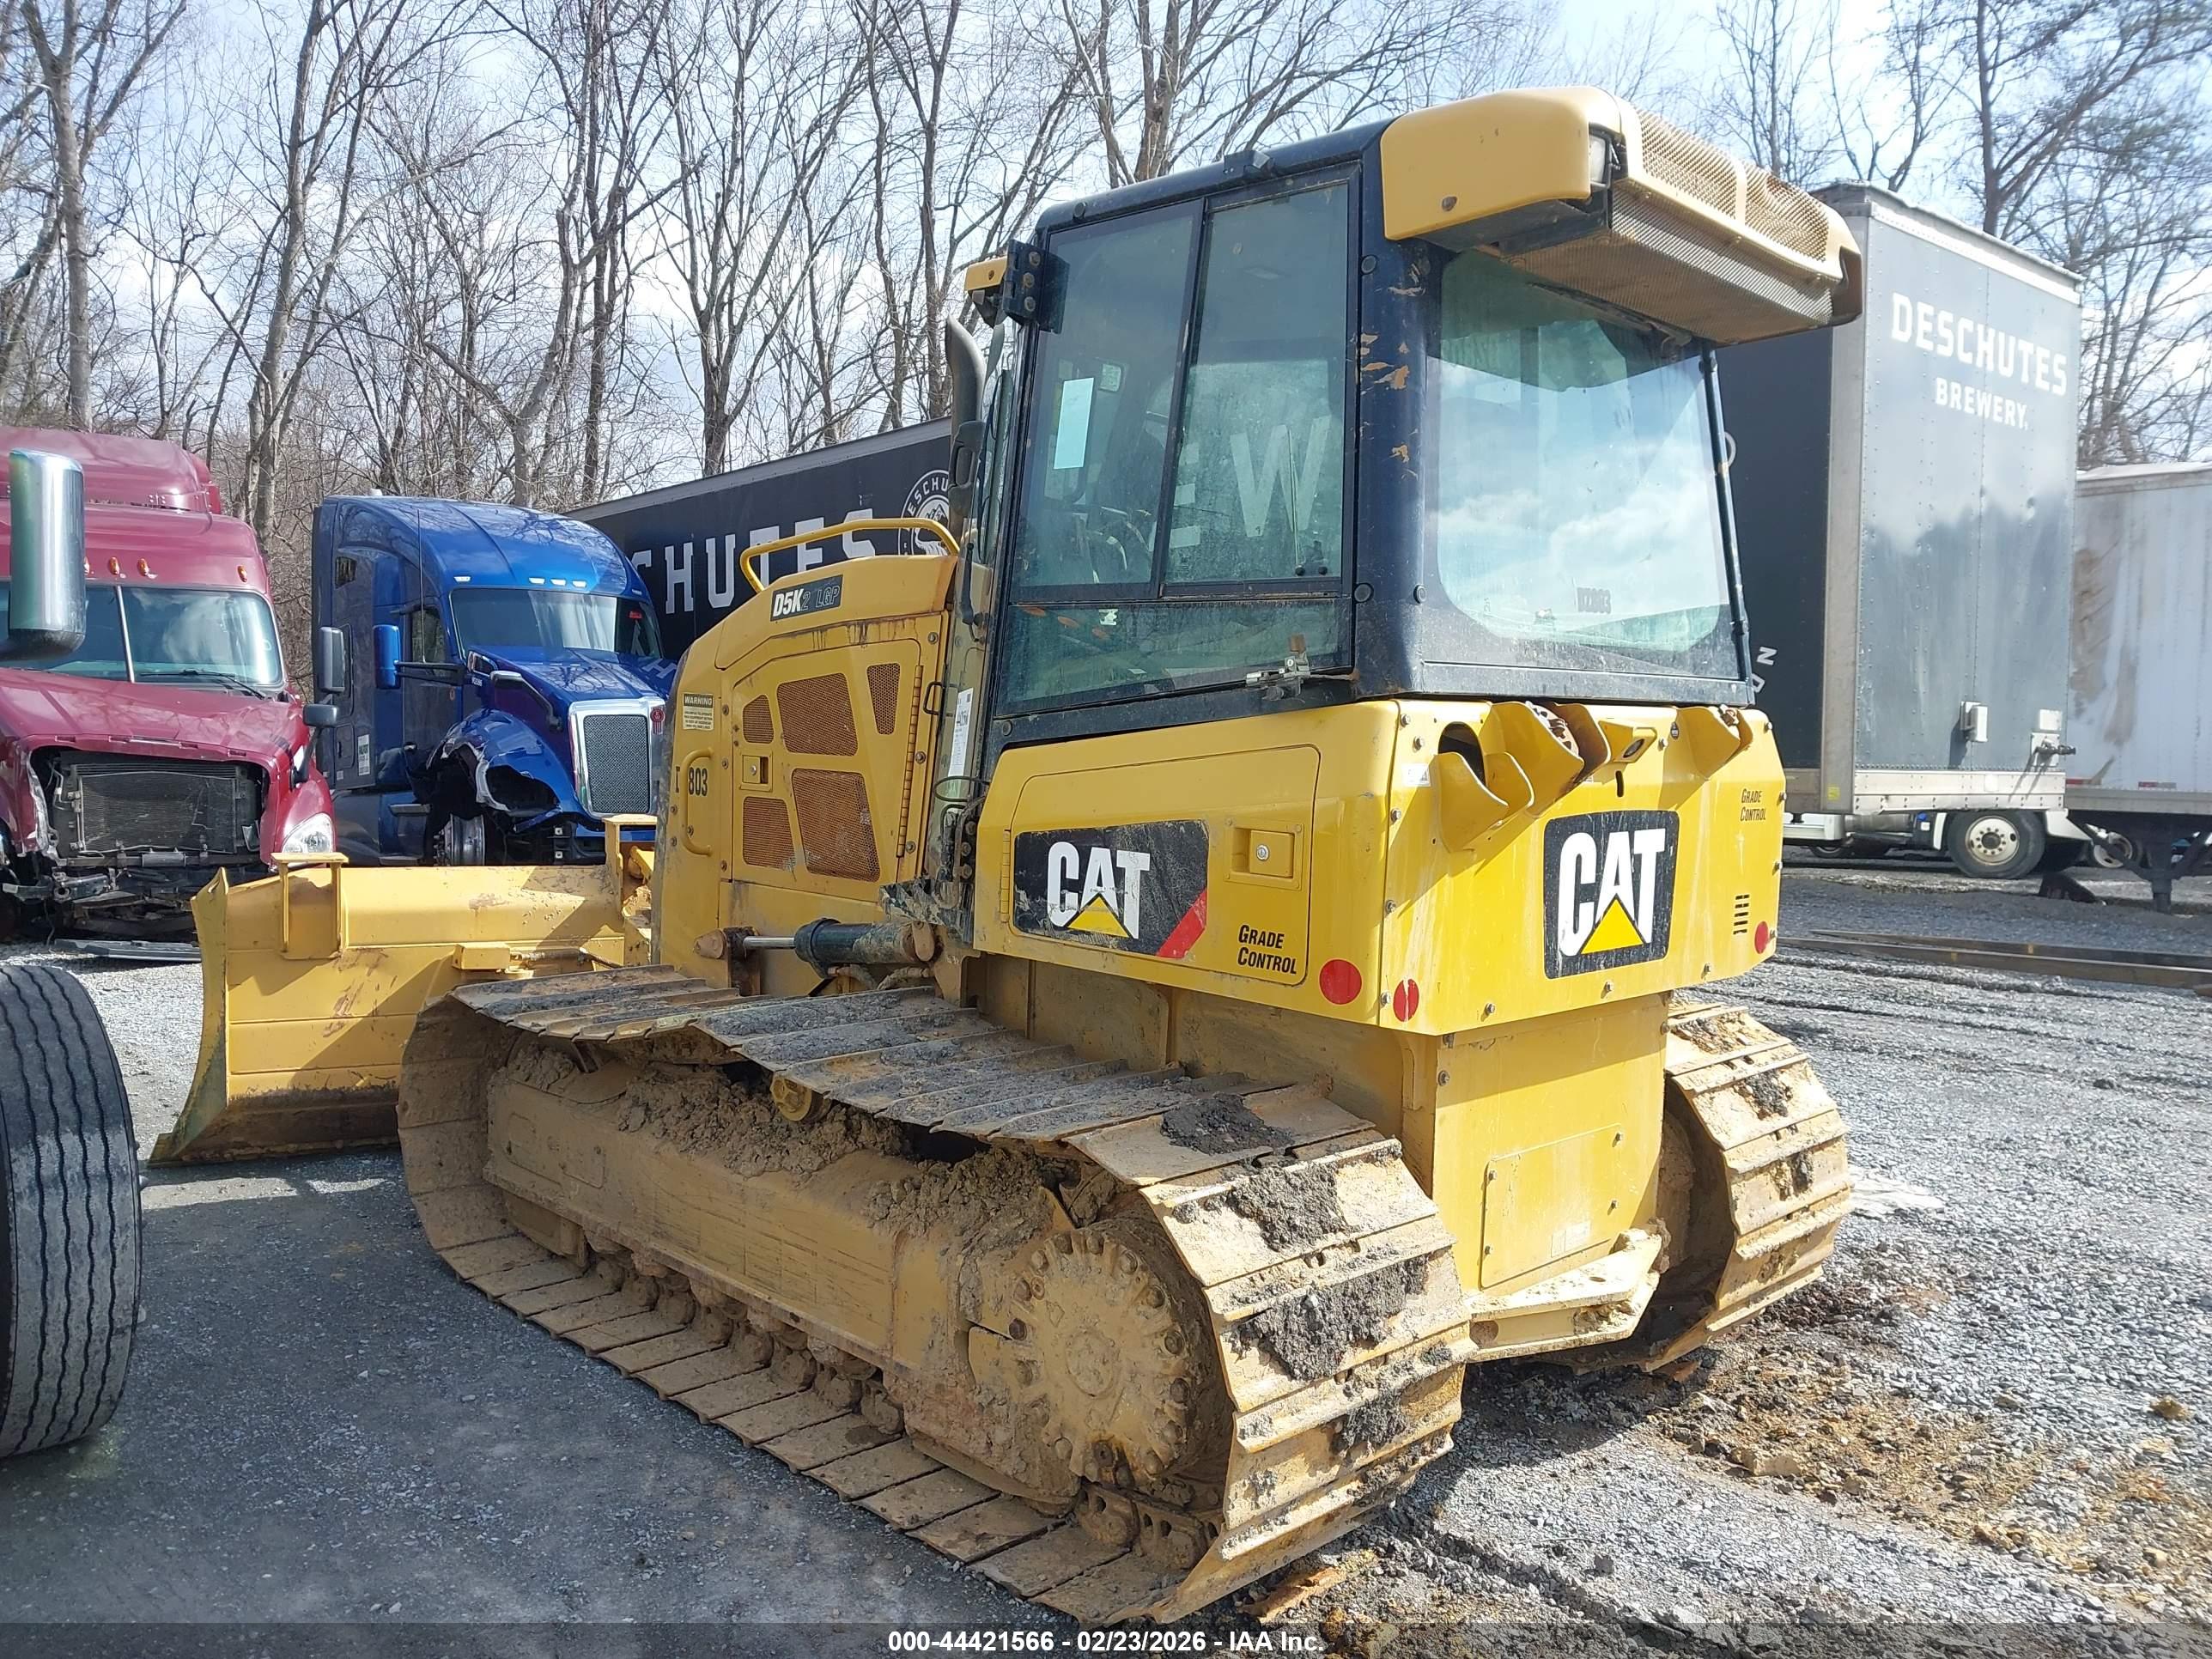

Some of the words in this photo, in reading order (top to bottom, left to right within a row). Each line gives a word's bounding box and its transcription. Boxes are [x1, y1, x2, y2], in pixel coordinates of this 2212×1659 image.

[1891, 292, 2068, 397] DESCHUTES
[773, 588, 811, 617] D5K2
[815, 585, 841, 608] LGP
[684, 696, 713, 706] WARNING
[1741, 788, 1763, 804] GRADE
[1740, 806, 1766, 822] CONTROL
[1047, 841, 1151, 939] CAT
[1557, 828, 1667, 957] CAT
[1238, 923, 1285, 950] GRADE
[1237, 946, 1297, 975] CONTROL
